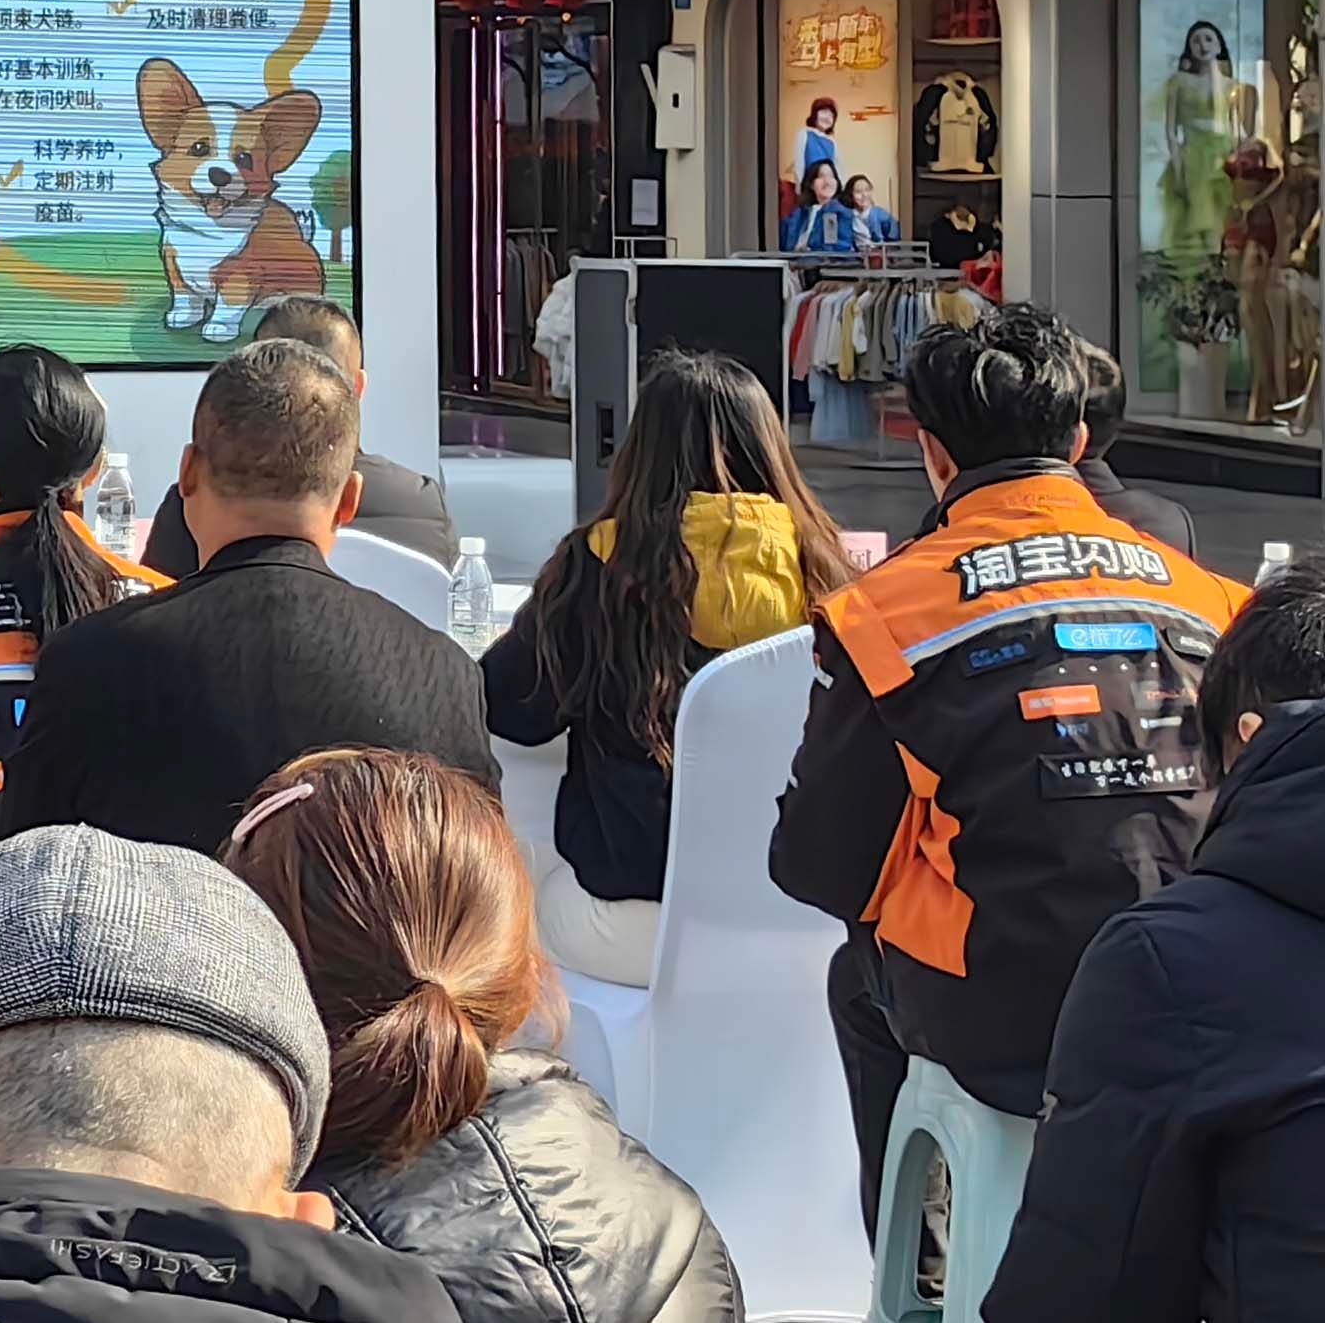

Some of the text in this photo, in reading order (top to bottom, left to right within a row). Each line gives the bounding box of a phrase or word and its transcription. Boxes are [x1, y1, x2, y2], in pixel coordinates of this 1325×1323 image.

[34, 169, 114, 191] 定期注射
[960, 532, 1170, 596] 淘宝闪购
